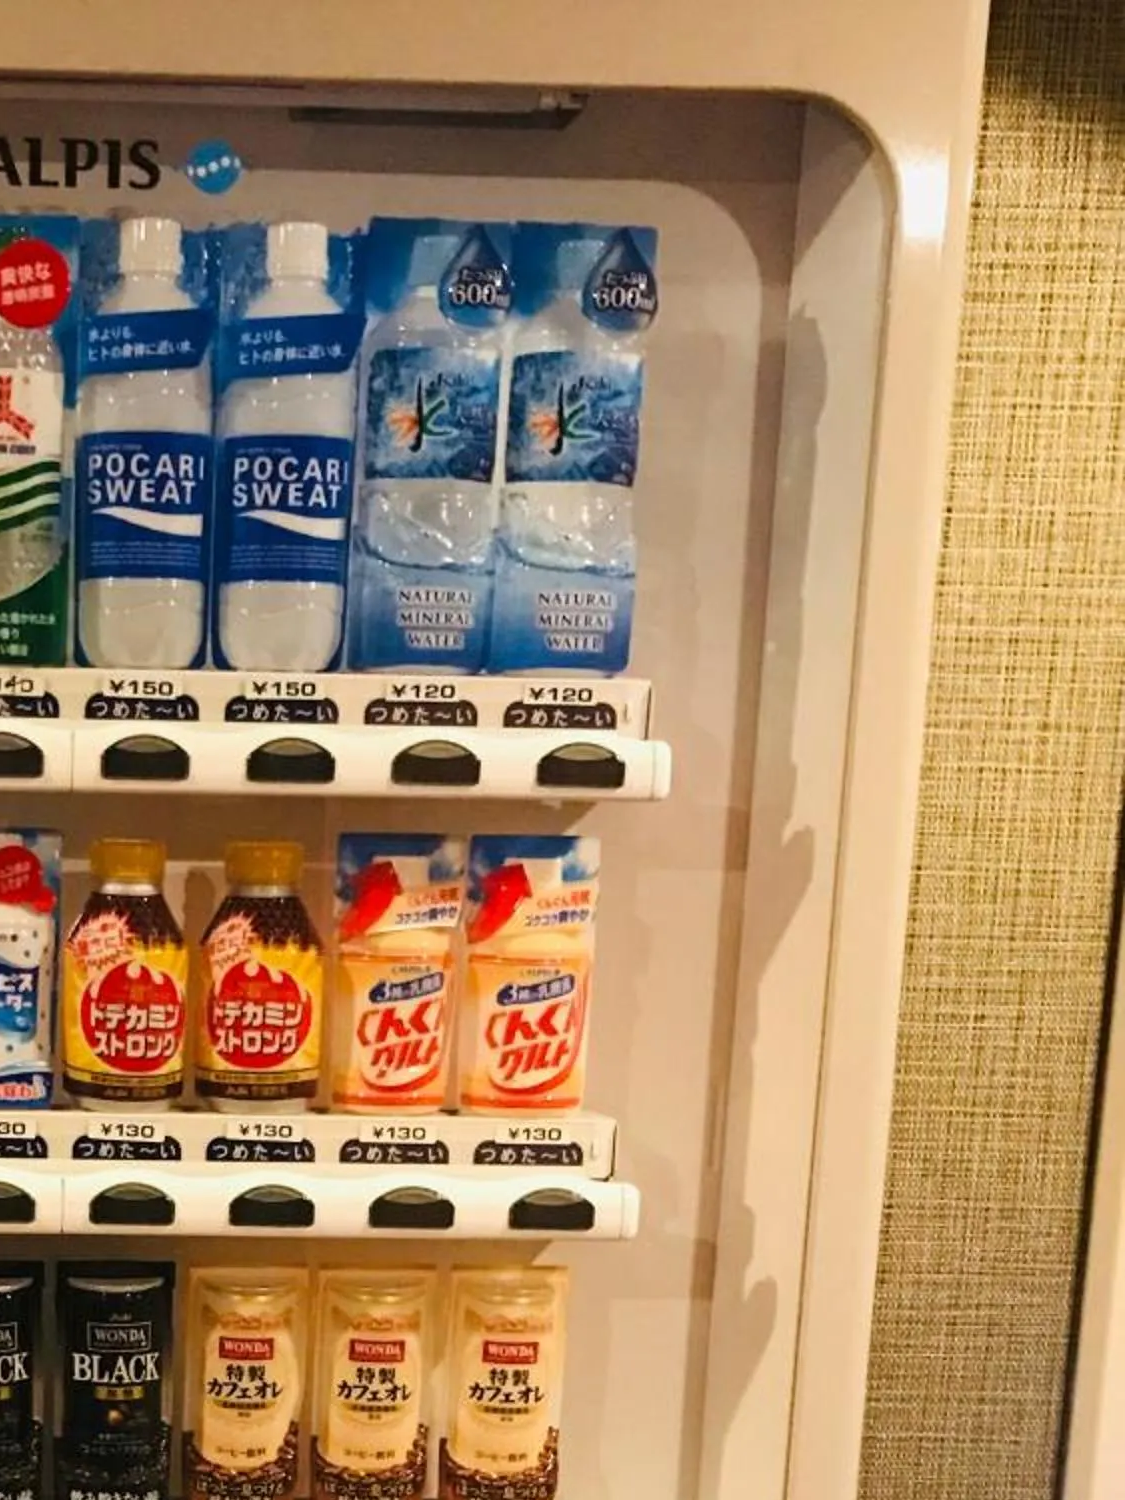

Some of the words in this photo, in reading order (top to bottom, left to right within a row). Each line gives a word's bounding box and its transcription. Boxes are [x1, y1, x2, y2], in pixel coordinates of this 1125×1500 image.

[88, 453, 204, 480] POCARI
[234, 457, 347, 484] POCARI
[88, 479, 196, 505] SWEAT
[233, 482, 342, 509] SWEAT
[110, 680, 173, 696] ¥150
[252, 682, 315, 696] ¥150
[391, 684, 455, 699] ¥120
[529, 687, 592, 702] ¥120
[90, 1003, 180, 1030] ドデカミン
[213, 1002, 302, 1025] ドデカミン
[94, 1033, 176, 1057] ストロング
[216, 1030, 297, 1055] ストロング
[101, 1124, 154, 1138] ¥130
[239, 1124, 292, 1138] ¥130
[373, 1127, 426, 1140] ¥130
[509, 1128, 561, 1141] ¥130
[93, 1328, 146, 1343] WONDA
[223, 1341, 270, 1354] WONDA
[354, 1344, 401, 1356] WONDA
[488, 1345, 535, 1358] WONDA
[72, 1352, 160, 1384] BLACK
[226, 1364, 266, 1382] 特製
[356, 1368, 396, 1384] 特製
[489, 1368, 529, 1386] 特製
[207, 1381, 283, 1400] カフェオレ
[337, 1383, 412, 1401] カフェオレ
[469, 1385, 545, 1403] カフェオレ
